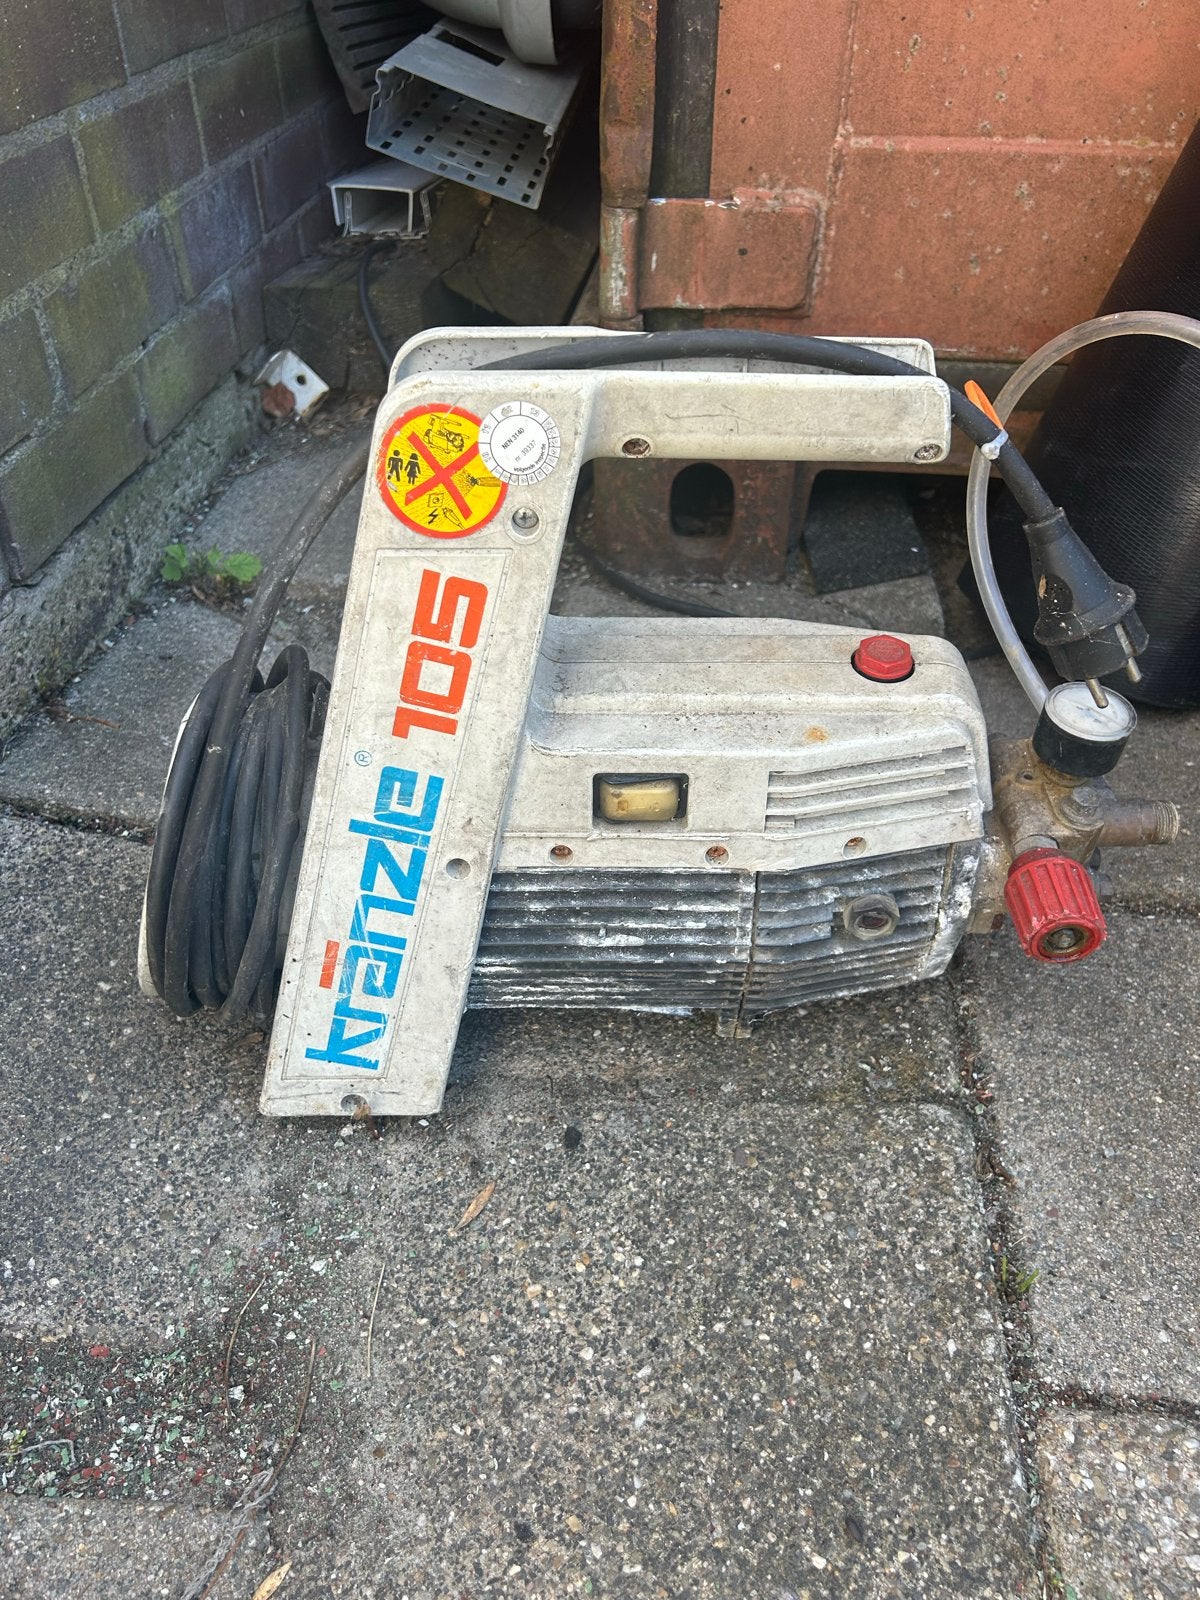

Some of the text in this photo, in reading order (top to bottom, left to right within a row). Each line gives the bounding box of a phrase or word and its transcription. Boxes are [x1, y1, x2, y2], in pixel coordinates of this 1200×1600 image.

[501, 428, 525, 450] NEN 3140
[514, 464, 535, 472] volgende
[392, 569, 489, 739] 105
